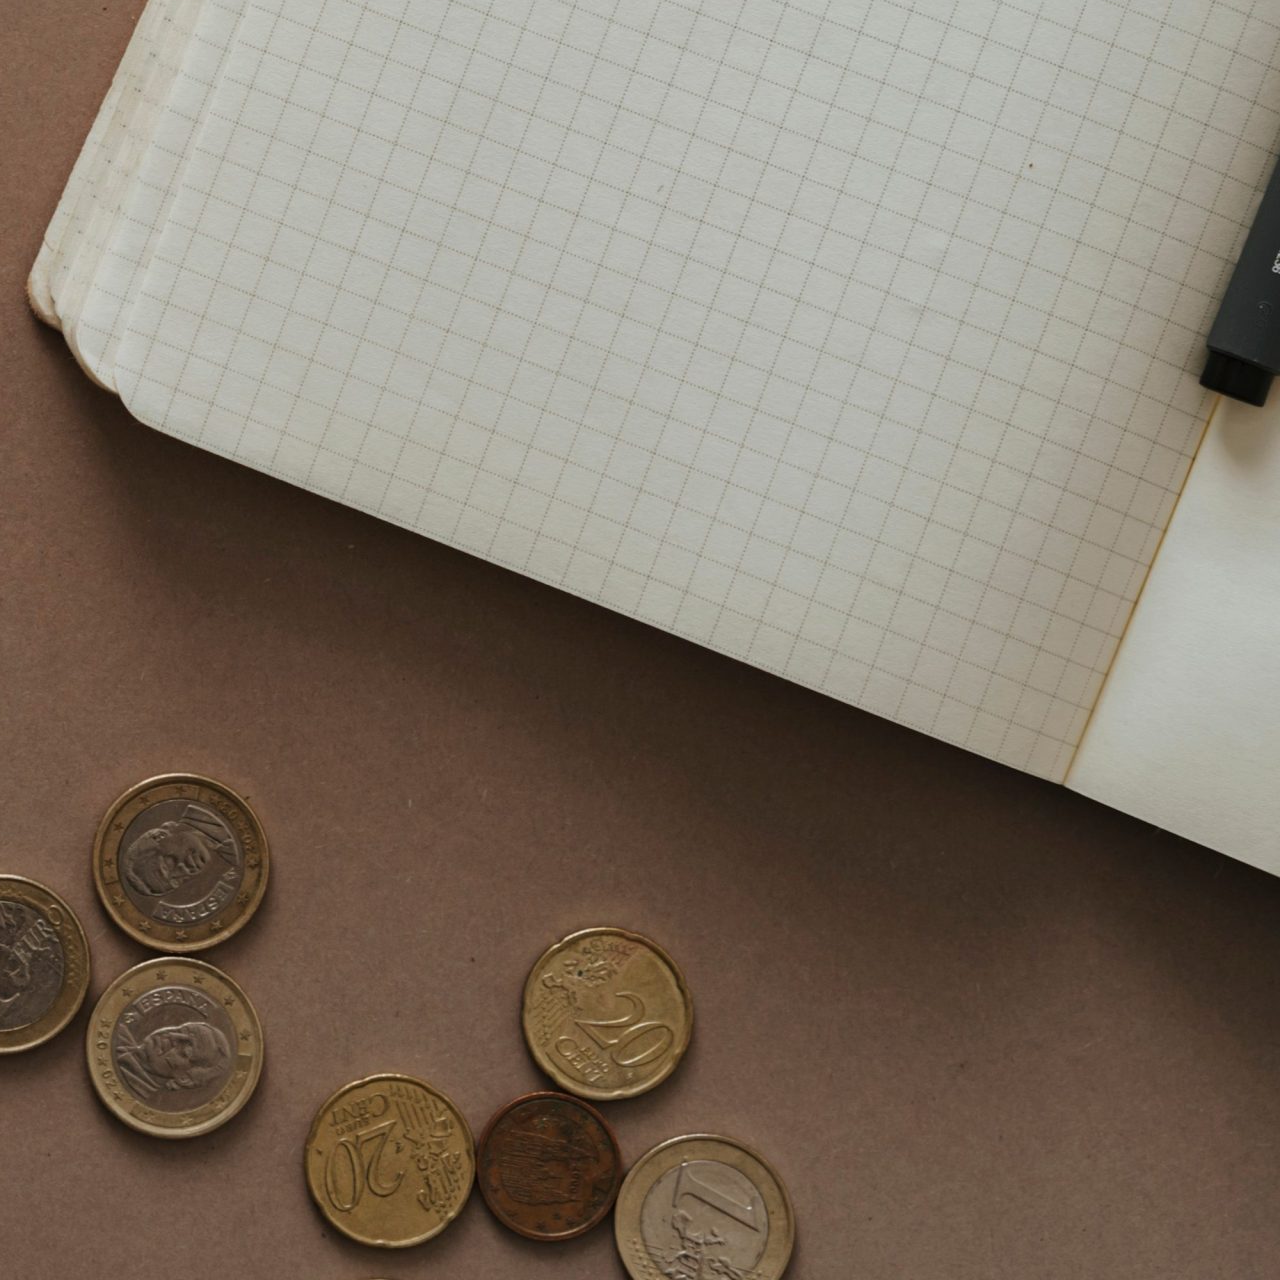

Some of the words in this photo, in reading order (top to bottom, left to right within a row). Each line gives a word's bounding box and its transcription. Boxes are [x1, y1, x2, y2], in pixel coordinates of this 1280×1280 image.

[575, 991, 674, 1067] 20
[330, 1093, 389, 1127] CENT
[325, 1121, 406, 1212] 20
